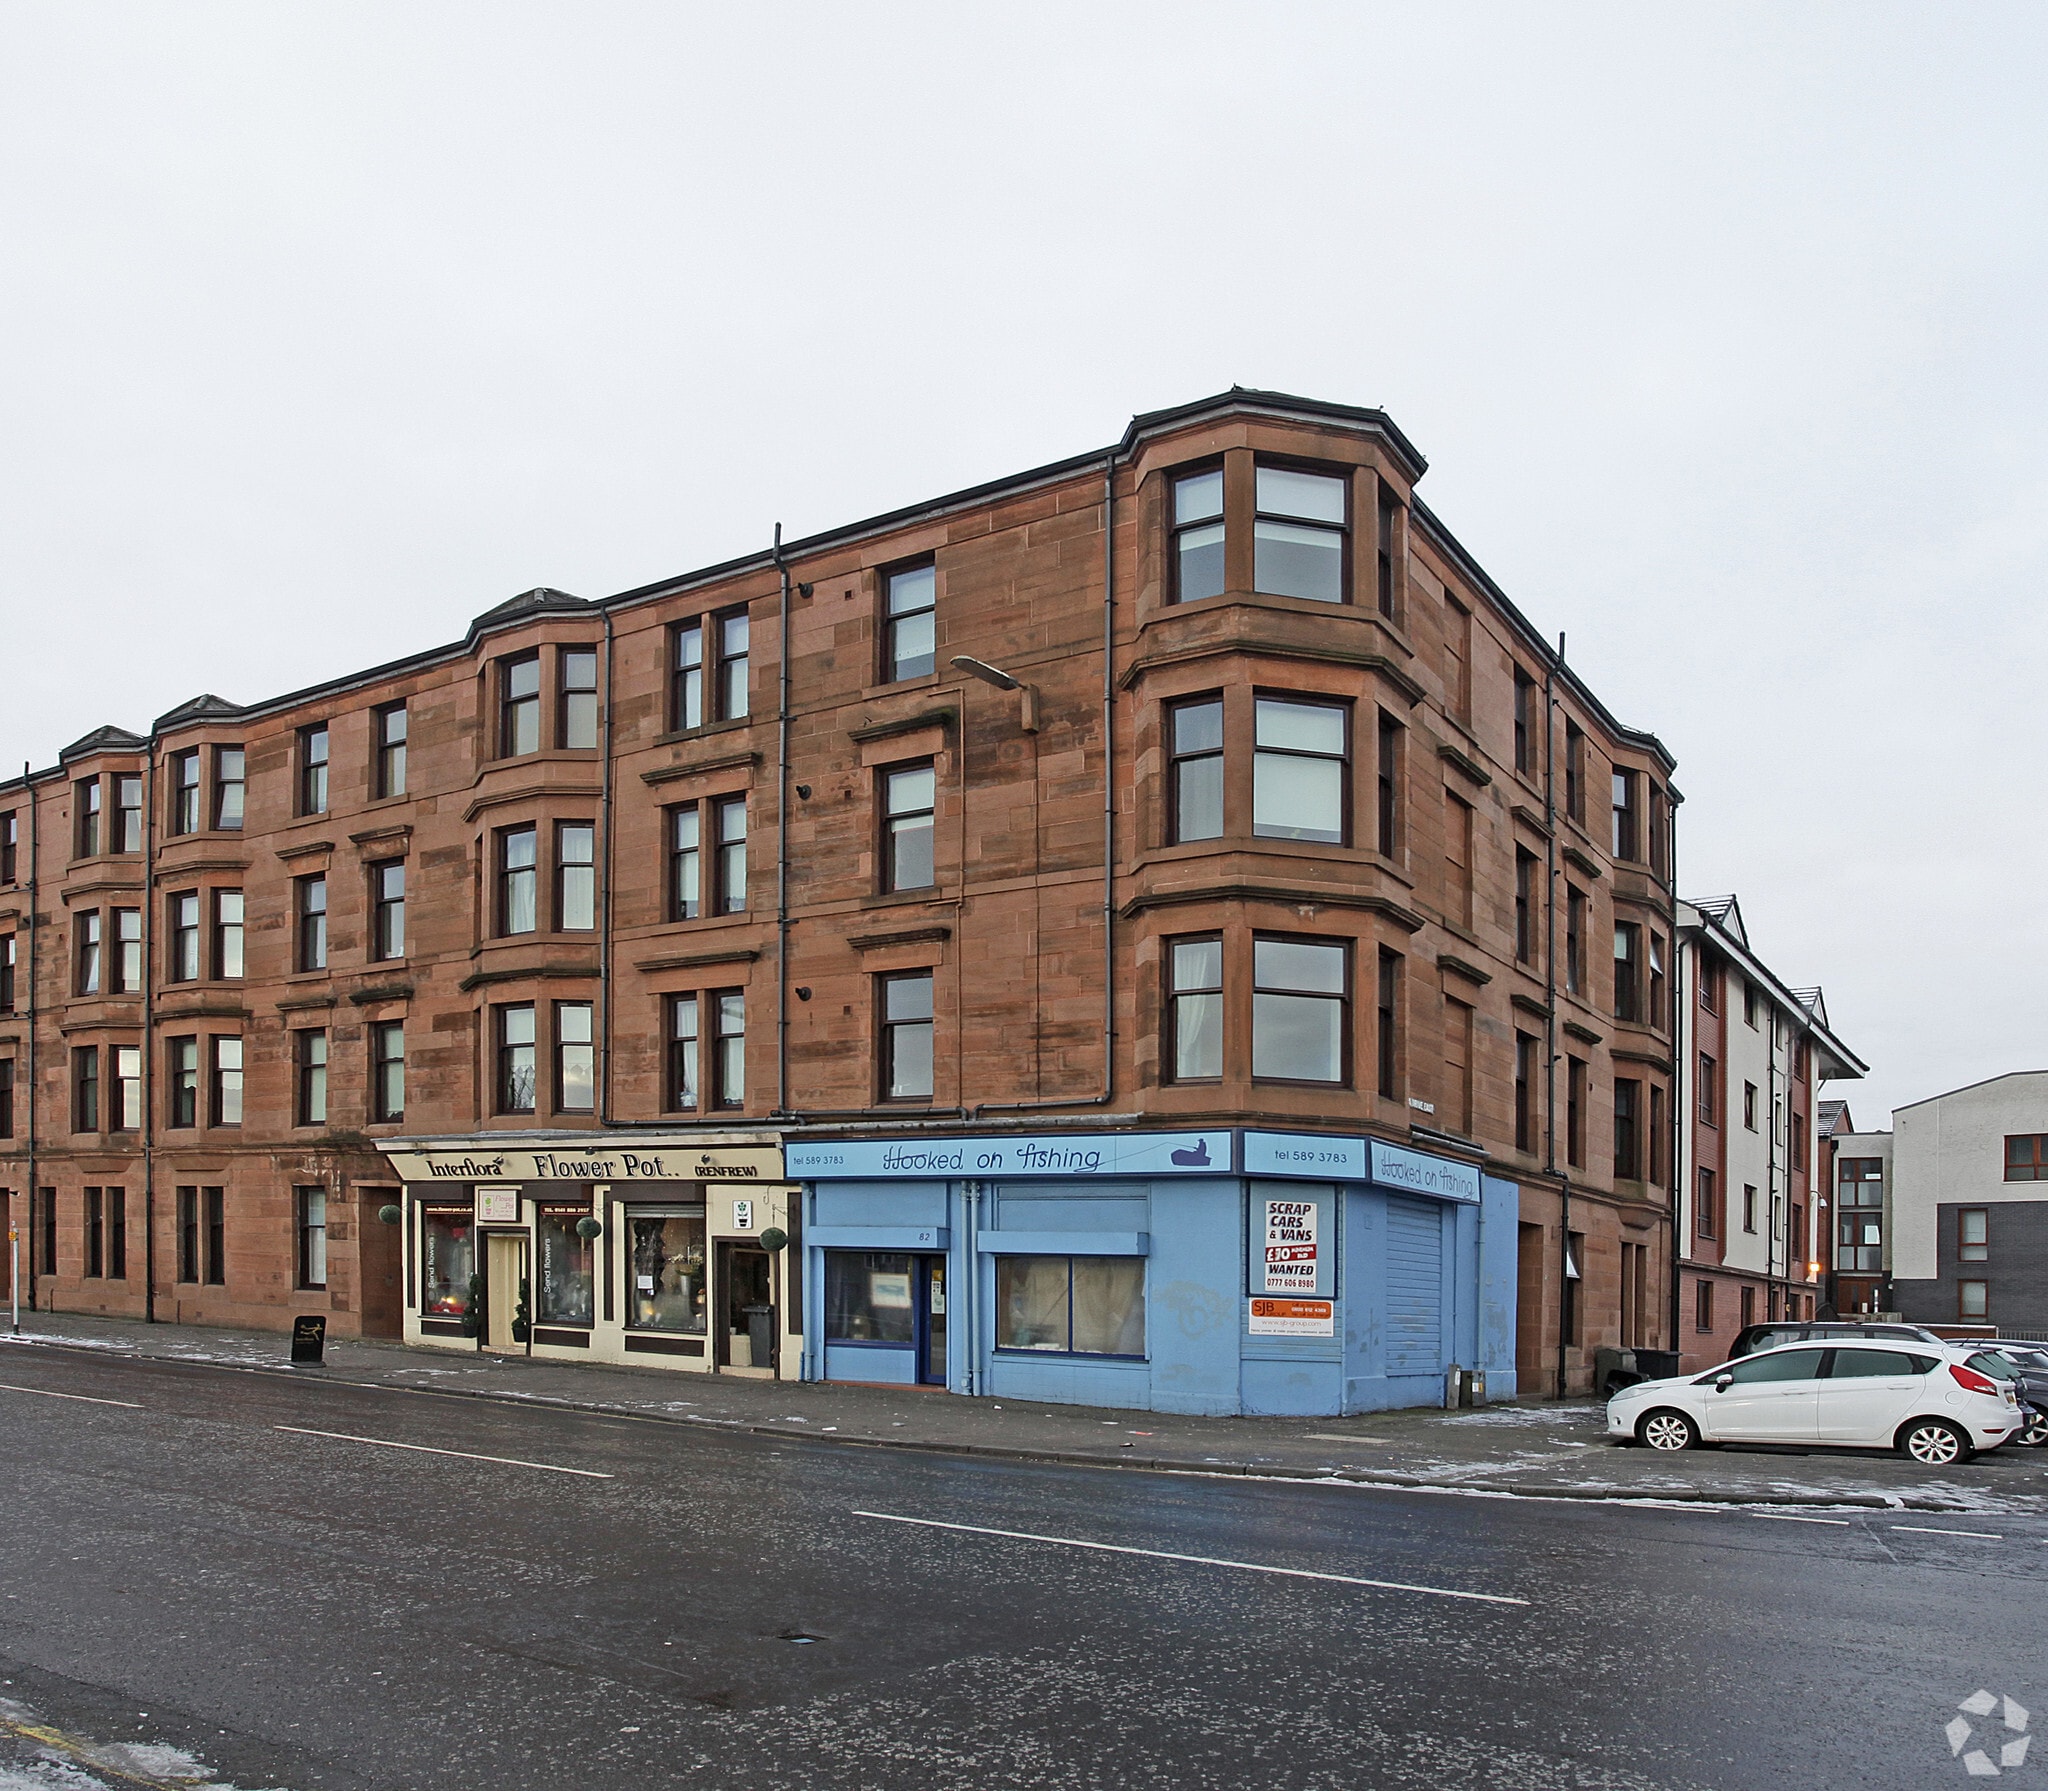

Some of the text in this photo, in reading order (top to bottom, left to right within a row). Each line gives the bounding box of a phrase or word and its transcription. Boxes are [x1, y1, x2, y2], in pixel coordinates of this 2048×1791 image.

[793, 1156, 844, 1165] tel 589 3783
[883, 1143, 1101, 1173] Hooked on fishing
[1275, 1150, 1348, 1163] tel 589 3783
[426, 1158, 503, 1177] Interflora
[532, 1153, 617, 1178] Flower
[695, 1165, 758, 1178] (RENFREW)
[1381, 1151, 1475, 1200] Hooked on fishing
[1269, 1202, 1312, 1216] SCRAP
[1271, 1215, 1304, 1228] CARS
[918, 1232, 930, 1241] 82
[1269, 1229, 1312, 1241] & VANS
[543, 1238, 551, 1293] Send flowers
[1269, 1264, 1314, 1276] WANTED
[1267, 1278, 1283, 1287] 0777
[1284, 1279, 1297, 1288] 606
[1254, 1301, 1275, 1316] SJB
